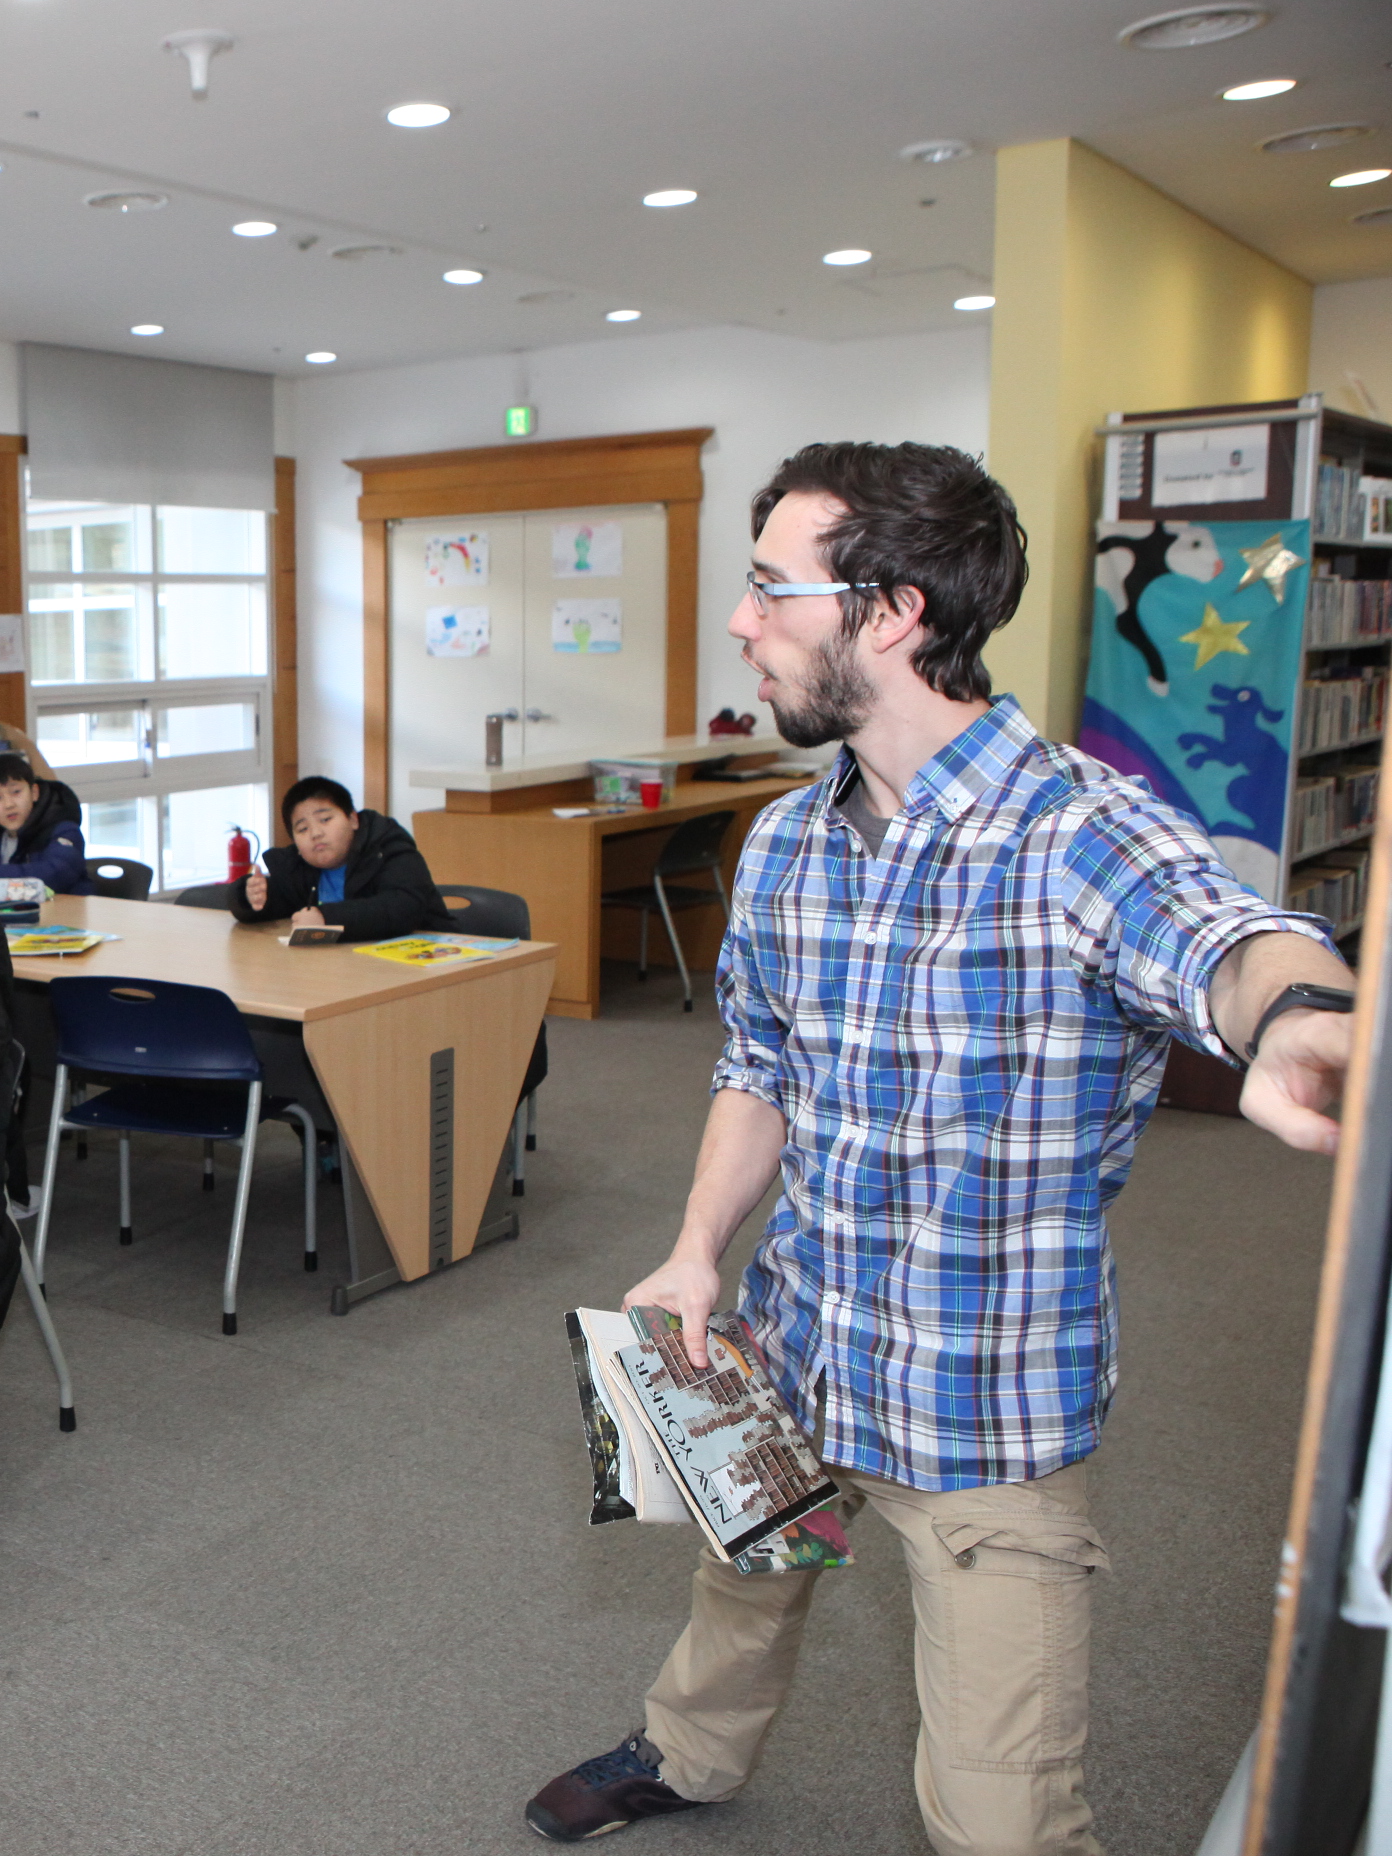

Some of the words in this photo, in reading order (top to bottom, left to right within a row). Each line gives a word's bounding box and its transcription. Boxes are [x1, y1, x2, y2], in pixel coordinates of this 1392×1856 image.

[635, 1357, 694, 1462] YORKER
[664, 1432, 681, 1460] THE
[690, 1465, 733, 1525] NEW
